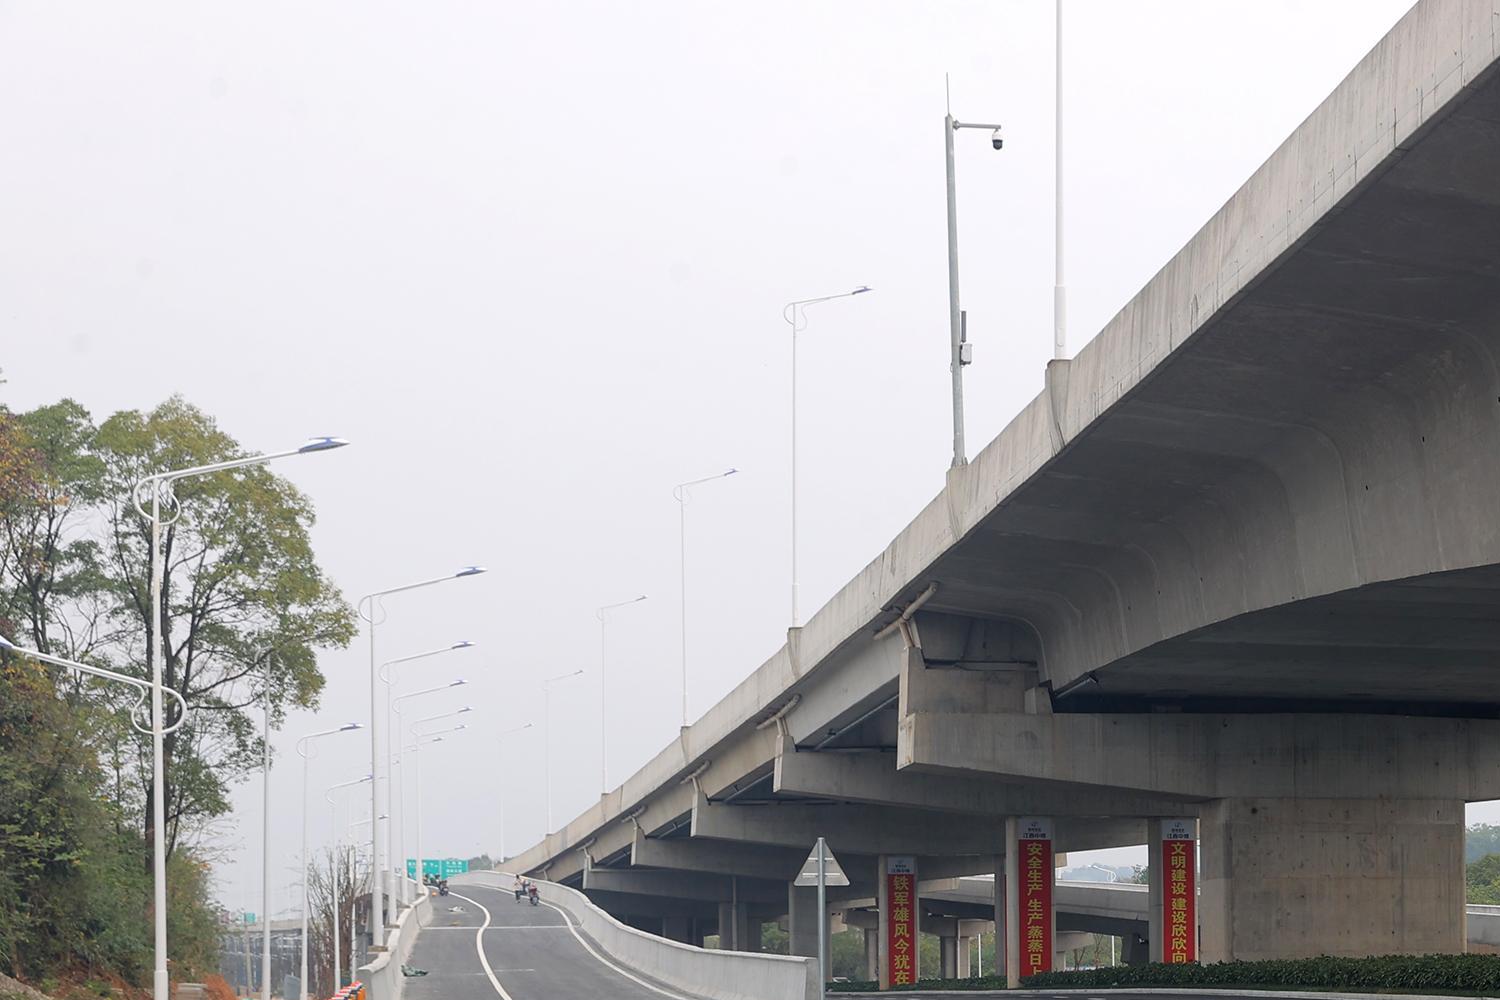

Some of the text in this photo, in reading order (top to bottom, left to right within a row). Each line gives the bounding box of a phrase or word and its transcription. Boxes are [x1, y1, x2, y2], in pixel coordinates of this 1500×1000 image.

[1027, 842, 1043, 896] 安全生产
[1171, 842, 1187, 895] 文明建设
[894, 874, 910, 985] 铁军雄风今犹在
